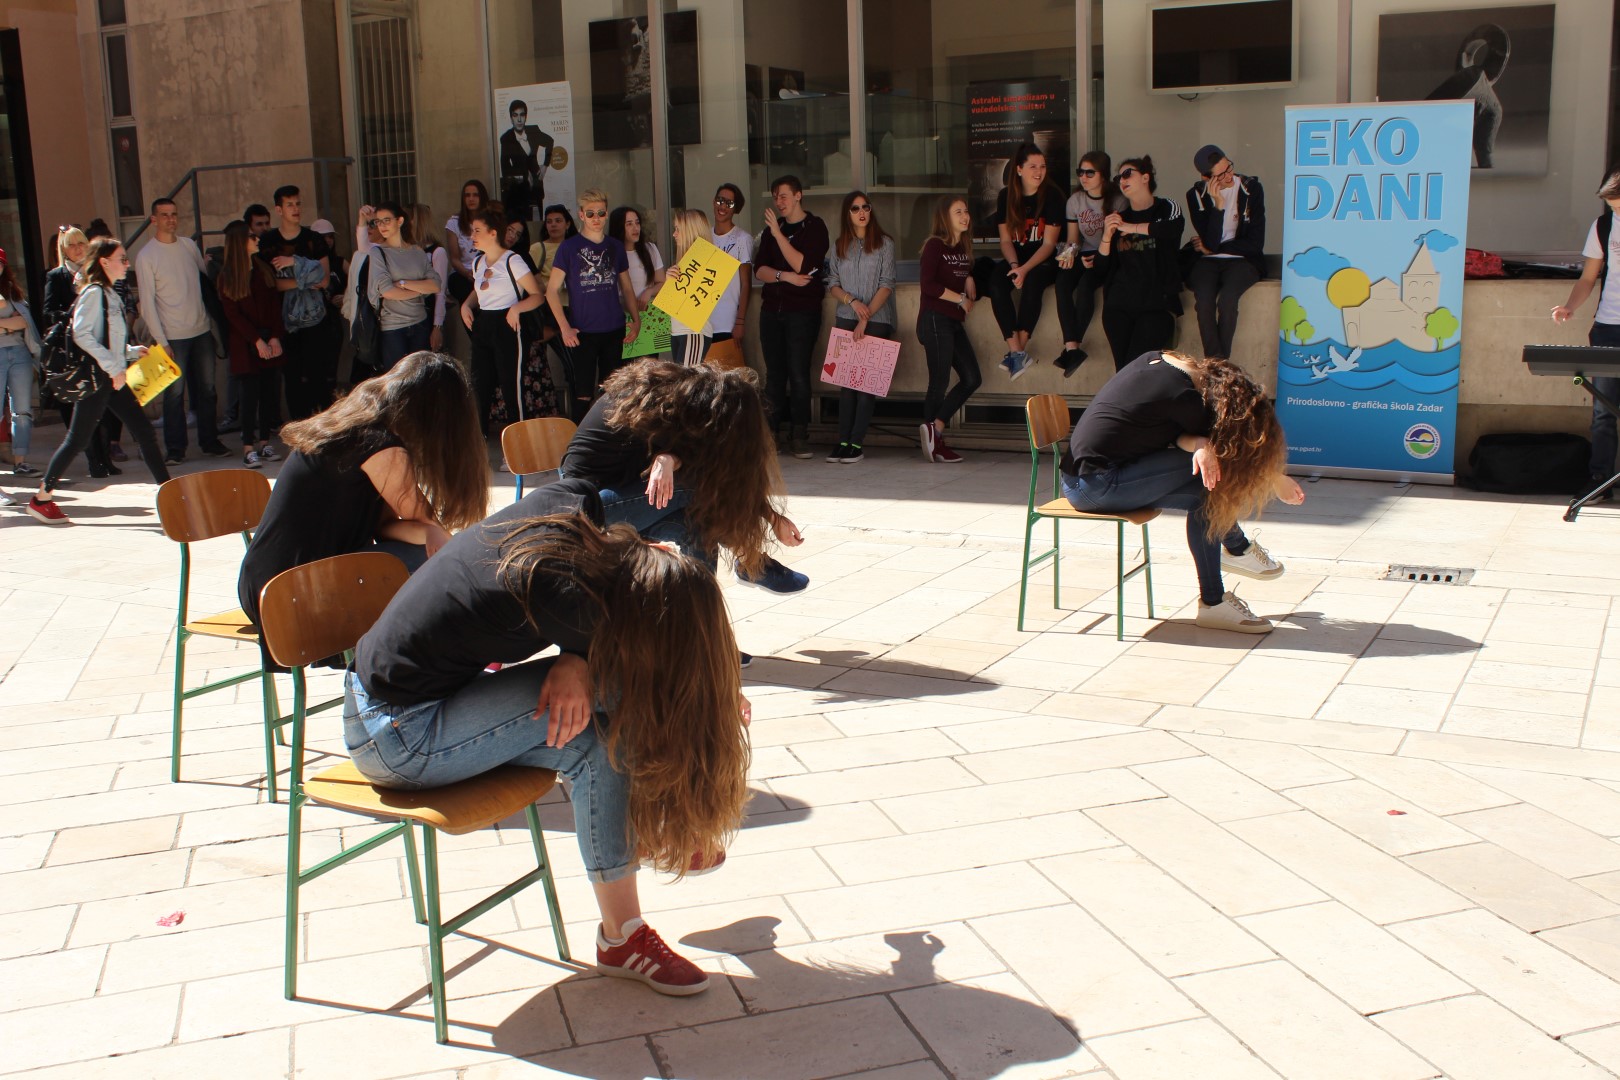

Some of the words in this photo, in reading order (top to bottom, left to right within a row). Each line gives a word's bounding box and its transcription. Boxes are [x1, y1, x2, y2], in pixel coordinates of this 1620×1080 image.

[971, 96, 1001, 105] Astralni
[1295, 117, 1420, 168] EKO
[1293, 173, 1444, 221] DANI
[674, 259, 701, 294] HUGS
[690, 267, 717, 307] FREE
[833, 336, 897, 372] FREE
[834, 363, 892, 393] HUGS
[1287, 397, 1345, 408] Prirodoslovno
[1352, 400, 1388, 410] grafička
[1390, 401, 1414, 411] škola
[1416, 403, 1443, 413] Zadar
